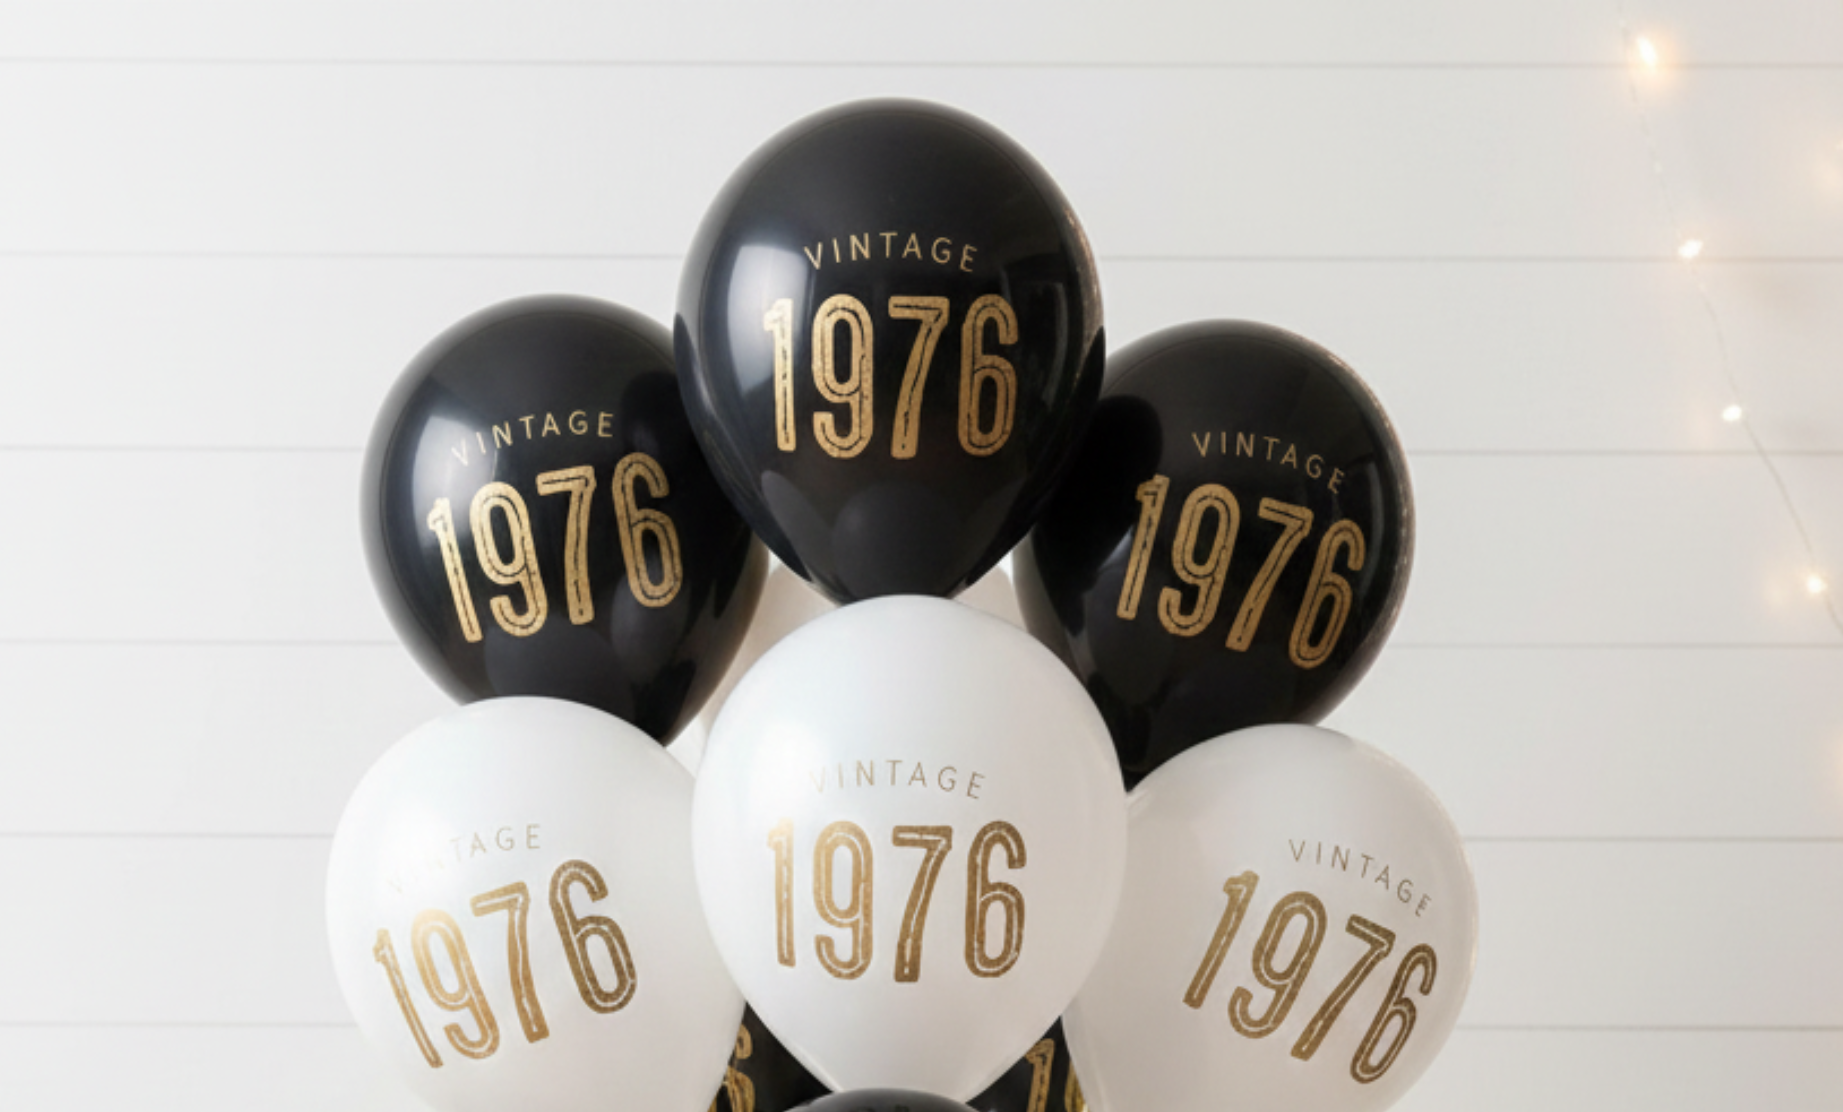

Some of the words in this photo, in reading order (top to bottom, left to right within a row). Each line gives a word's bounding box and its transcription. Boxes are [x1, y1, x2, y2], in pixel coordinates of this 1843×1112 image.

[804, 231, 977, 272] VINTAGE
[451, 410, 614, 467] VINTAGE
[763, 294, 1018, 459] 1976
[1192, 431, 1346, 495] VINTAGE
[427, 452, 683, 643] 1976
[1116, 473, 1366, 669] 1976
[809, 759, 985, 799] VINTAGE
[767, 817, 1027, 983] 1976
[1289, 838, 1432, 918] VINTAGE
[372, 859, 637, 1068] 1976
[1182, 870, 1437, 1084] 1976
